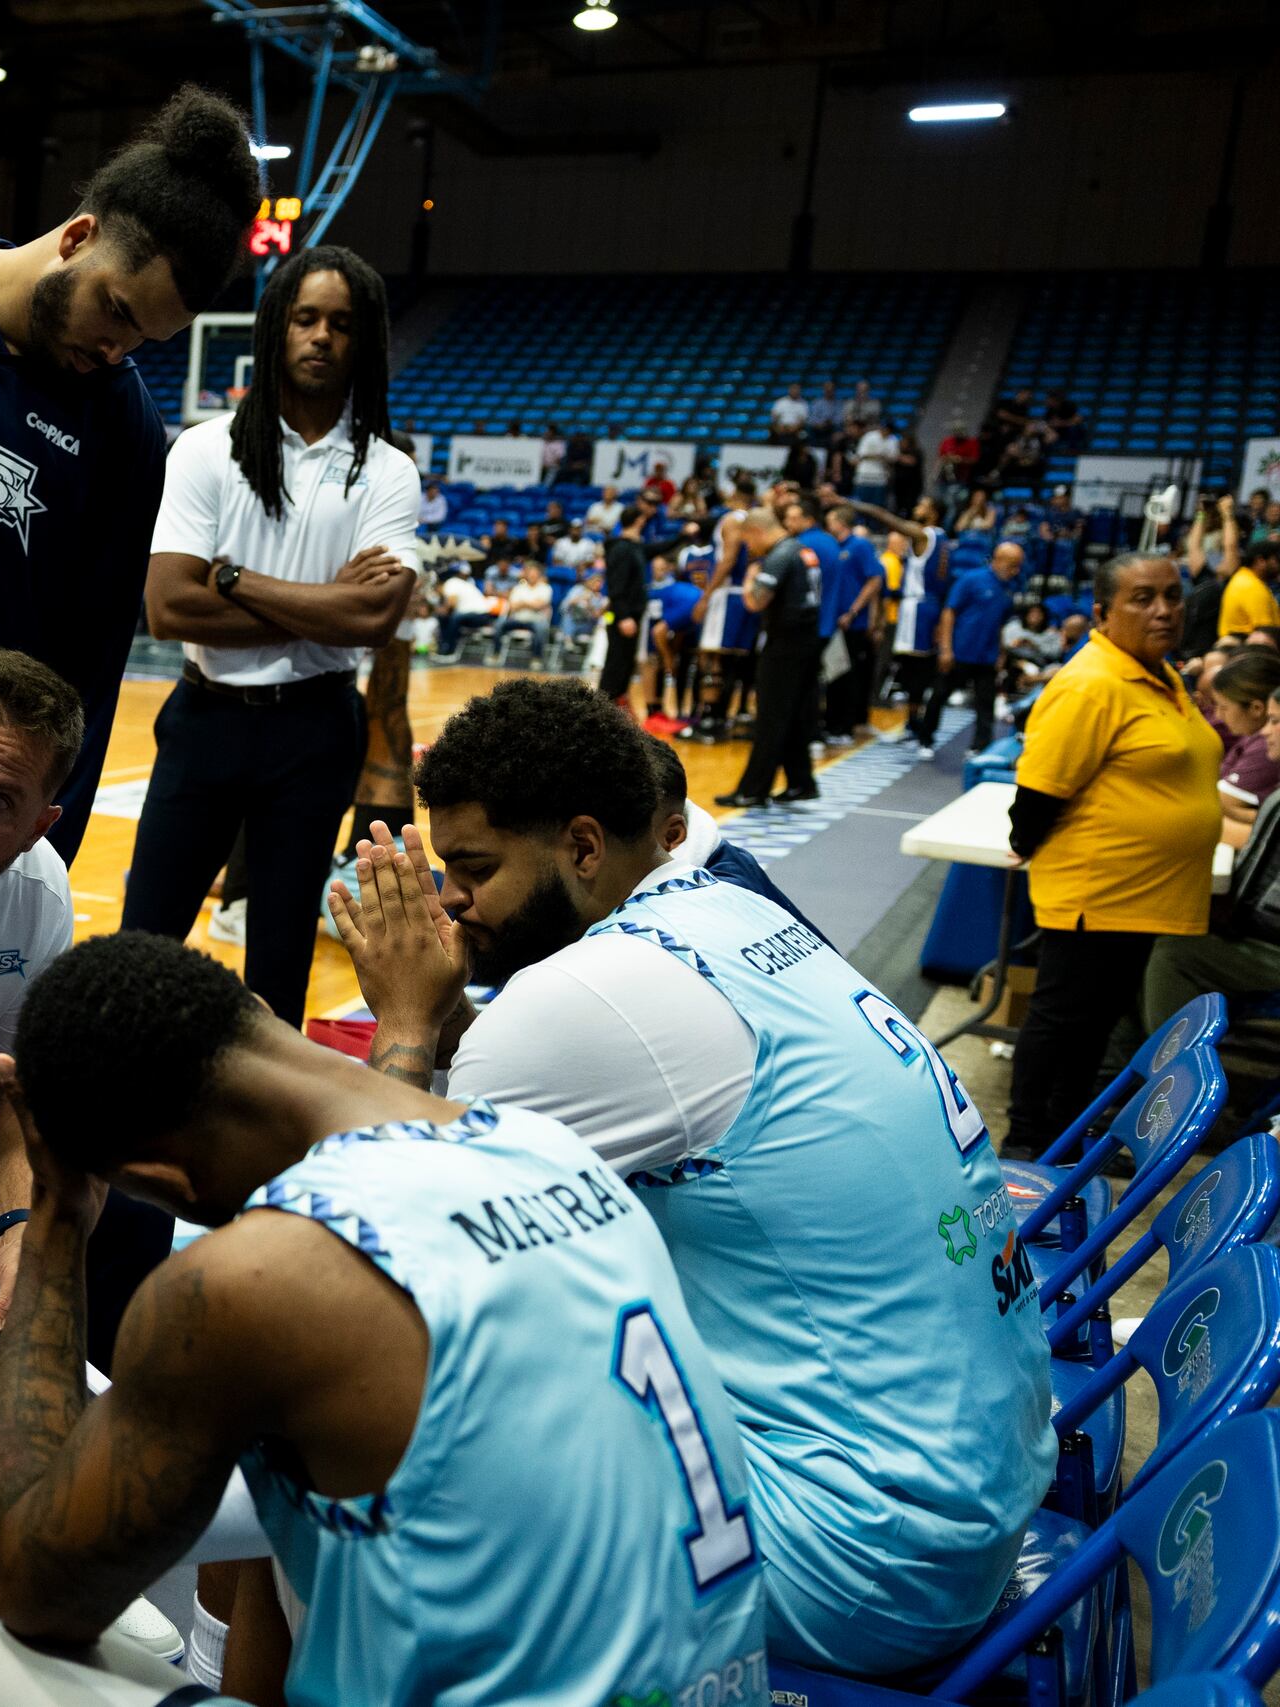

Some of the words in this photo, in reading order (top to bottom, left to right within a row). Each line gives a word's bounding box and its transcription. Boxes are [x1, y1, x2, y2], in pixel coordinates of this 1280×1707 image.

[250, 219, 292, 255] 24
[850, 988, 990, 1168] 2
[612, 1300, 760, 1602] 1
